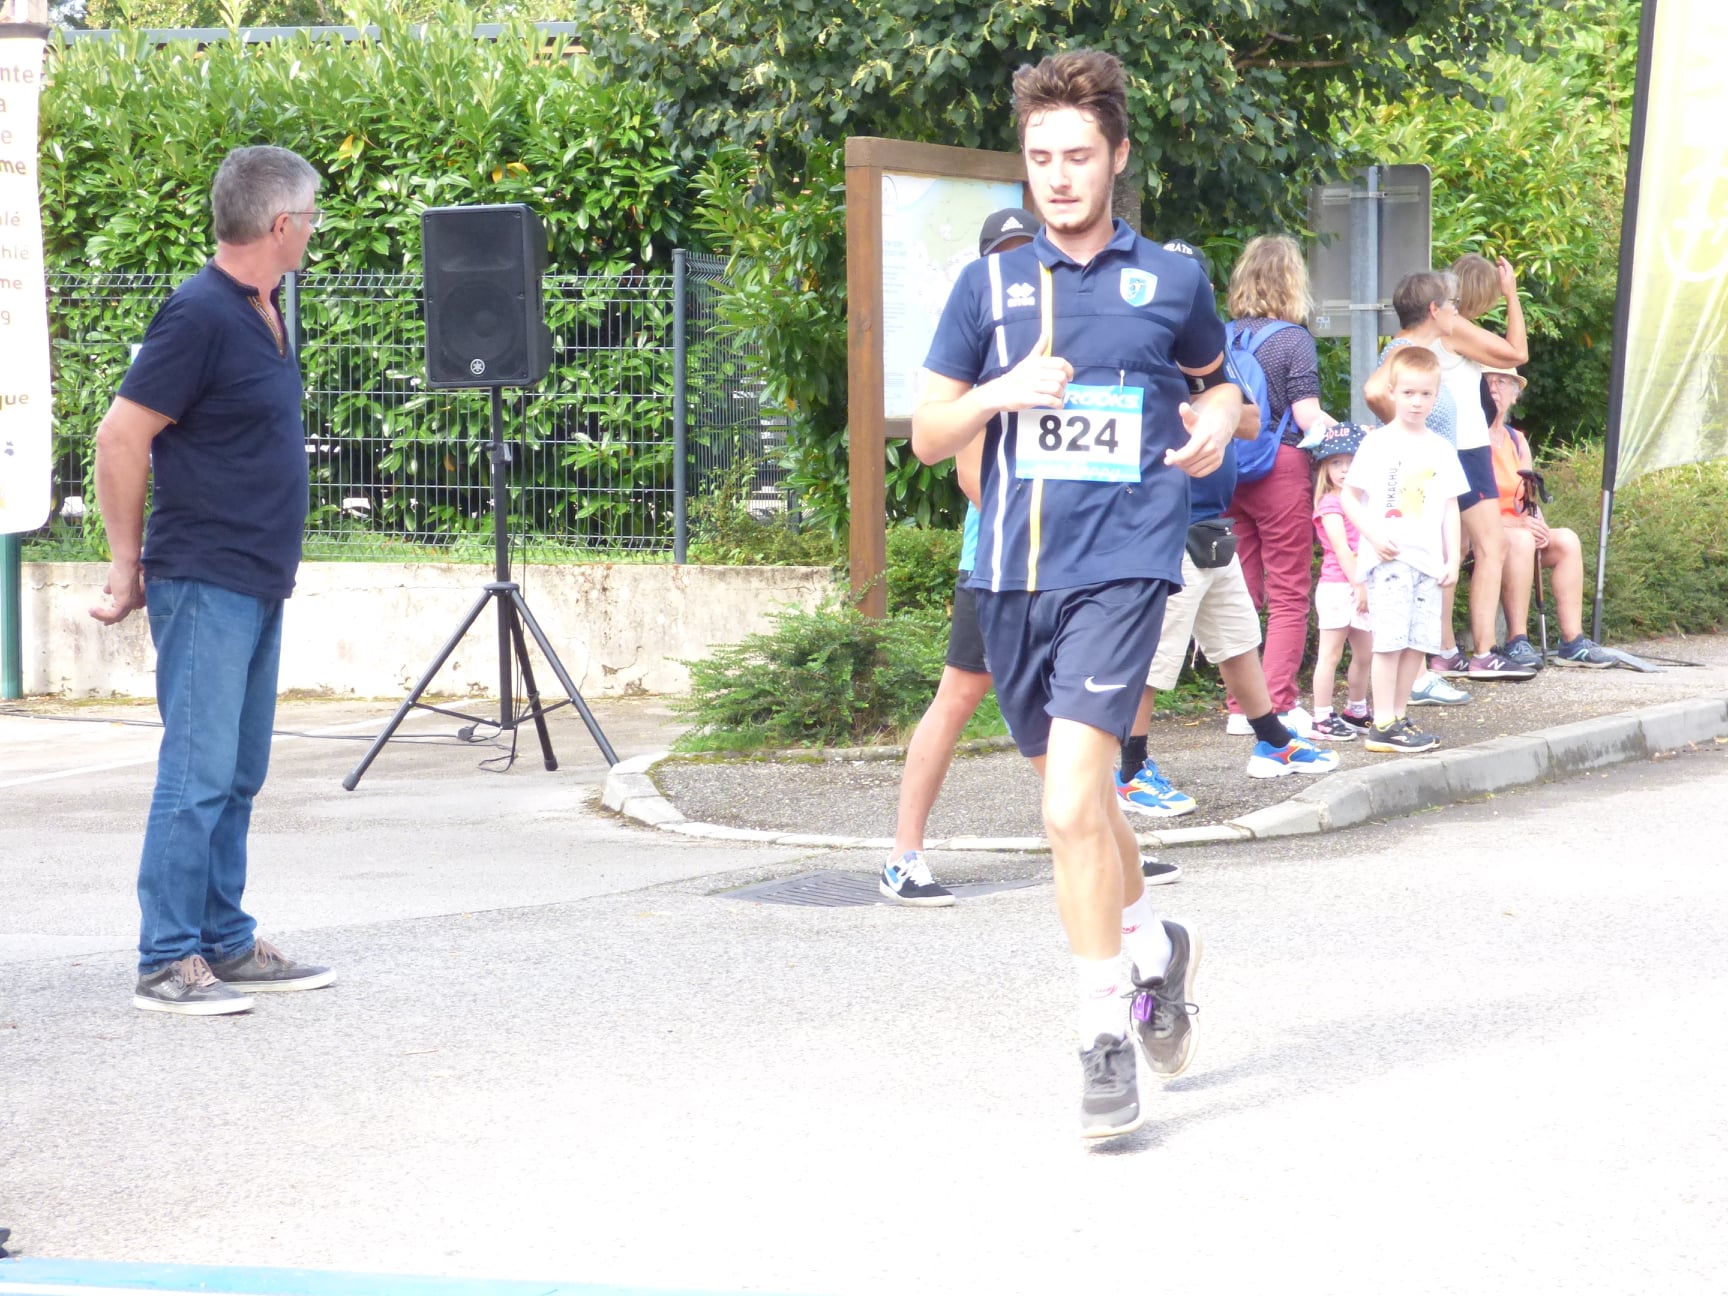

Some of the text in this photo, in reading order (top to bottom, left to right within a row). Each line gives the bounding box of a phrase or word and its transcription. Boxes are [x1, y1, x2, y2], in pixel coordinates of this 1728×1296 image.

[0, 210, 20, 226] lé
[0, 393, 30, 411] ue
[1038, 414, 1119, 454] 824
[1385, 467, 1399, 508] PIKACHU
